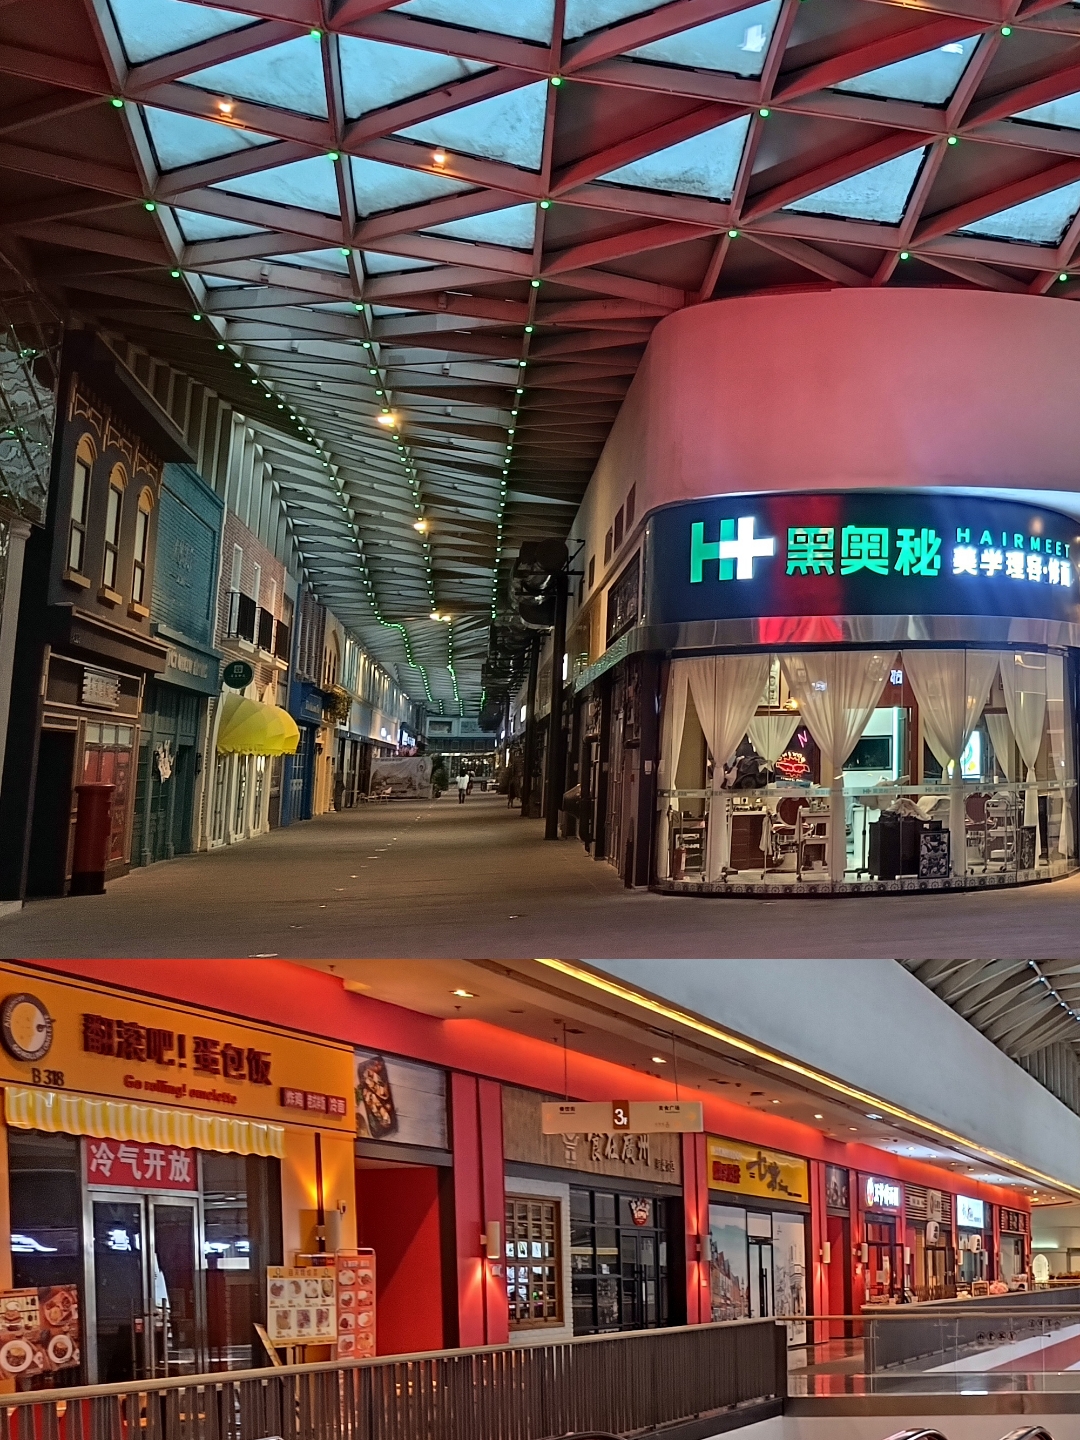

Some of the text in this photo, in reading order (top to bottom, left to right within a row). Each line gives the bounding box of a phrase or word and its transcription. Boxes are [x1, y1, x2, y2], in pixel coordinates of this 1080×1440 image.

[785, 524, 942, 577] 黑奥秘
[956, 527, 1070, 558] HAIRMEET
[123, 1074, 142, 1090] Go
[89, 1142, 192, 1183] 冷气开放
